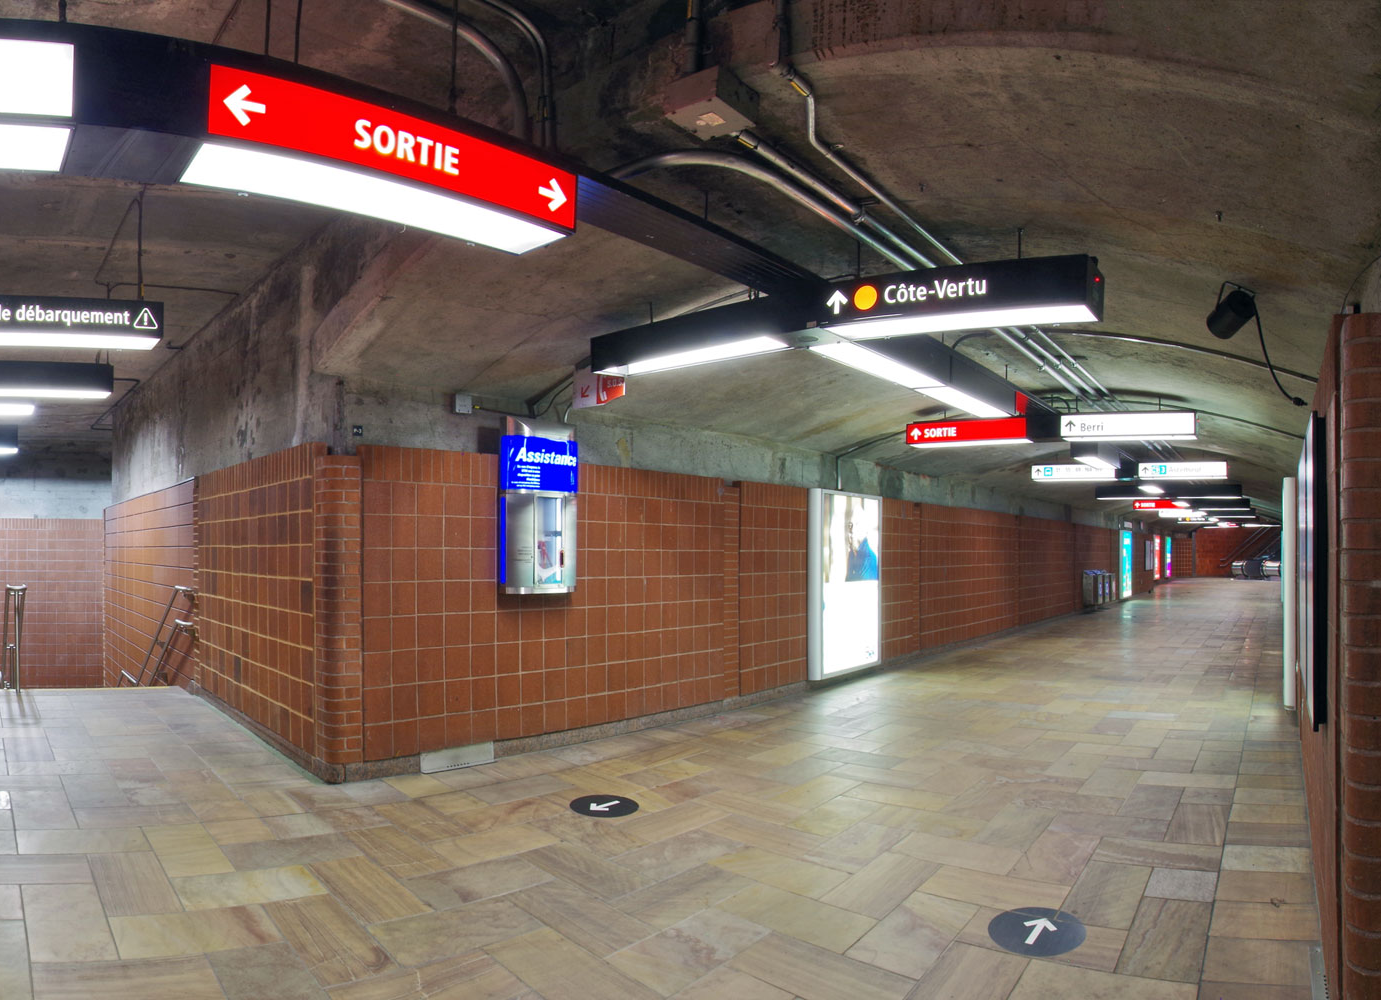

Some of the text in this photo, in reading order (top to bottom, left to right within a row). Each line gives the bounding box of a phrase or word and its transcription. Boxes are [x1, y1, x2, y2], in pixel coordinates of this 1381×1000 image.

[354, 119, 459, 175] SORTIE
[884, 275, 987, 304] Côte-Vertu
[15, 306, 130, 327] débarquement
[923, 427, 957, 438] SORTIE
[1080, 422, 1104, 433] Berri
